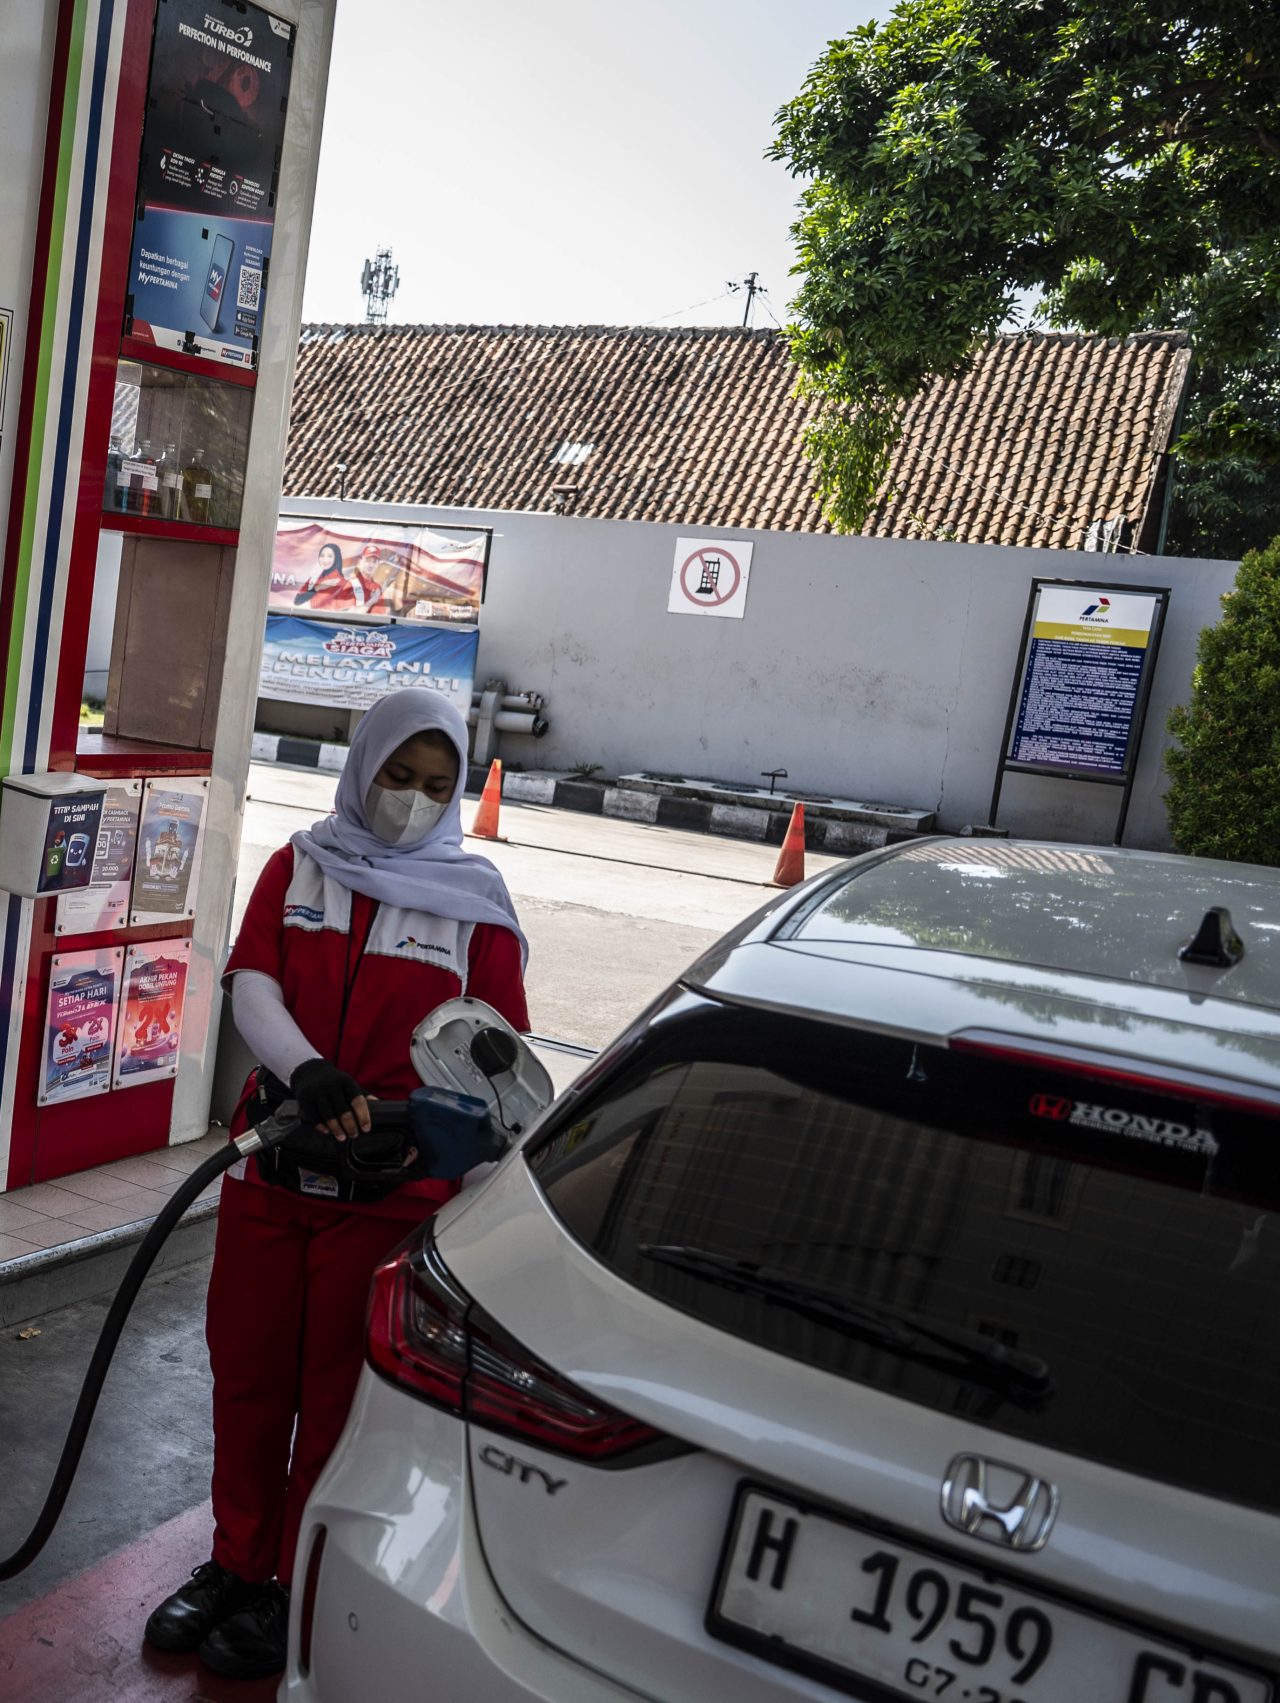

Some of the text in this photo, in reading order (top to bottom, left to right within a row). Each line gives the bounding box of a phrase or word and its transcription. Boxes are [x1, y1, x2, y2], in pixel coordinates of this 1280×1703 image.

[203, 18, 245, 43] TURBO
[178, 22, 272, 73] PERFECTION IN PERFORMANCE
[140, 248, 189, 270] Dapatkan berbagai
[139, 260, 190, 282] keuntungan dengan
[329, 645, 387, 656] SIAGA
[278, 650, 431, 674] MELAYANI
[262, 660, 376, 683] EPENUH
[388, 672, 460, 692] HATI
[53, 803, 99, 815] TITIP SAMPAH
[63, 813, 86, 823] DI SINI
[416, 942, 452, 956] PERTAMINA
[158, 972, 178, 981] PEKAN
[58, 992, 86, 1008] SETIAP
[87, 986, 107, 999] HARI
[1071, 1101, 1218, 1146] HONDA
[479, 1443, 569, 1496] CITY
[745, 1508, 799, 1591] H
[850, 1549, 1054, 1686] 1959
